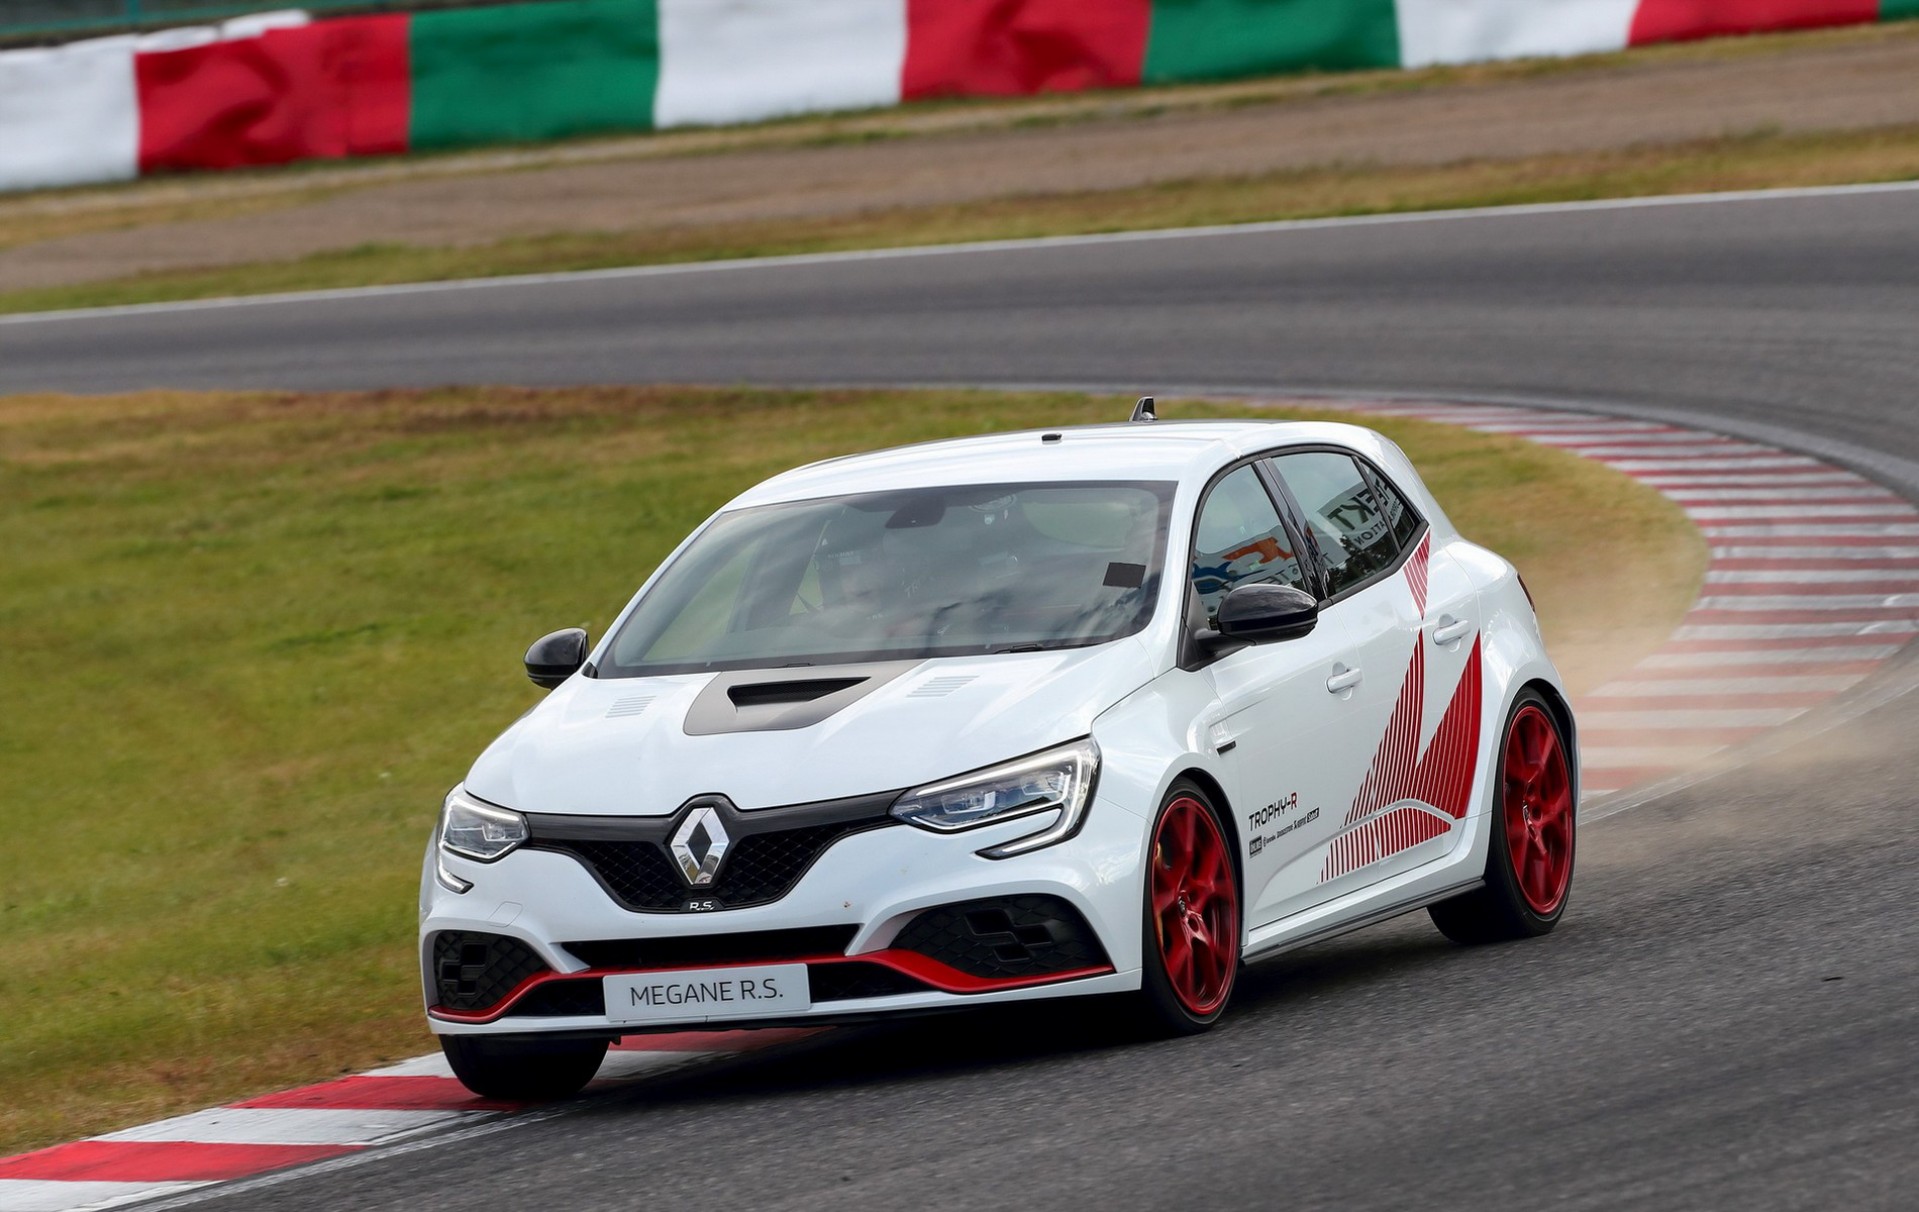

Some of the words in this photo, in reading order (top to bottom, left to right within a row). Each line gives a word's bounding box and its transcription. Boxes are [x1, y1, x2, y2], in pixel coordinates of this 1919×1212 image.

[1249, 792, 1297, 831] TROPHY-R
[690, 902, 715, 911] R.S.
[630, 981, 732, 1006] MEGANE
[740, 978, 784, 1000] R.S.
